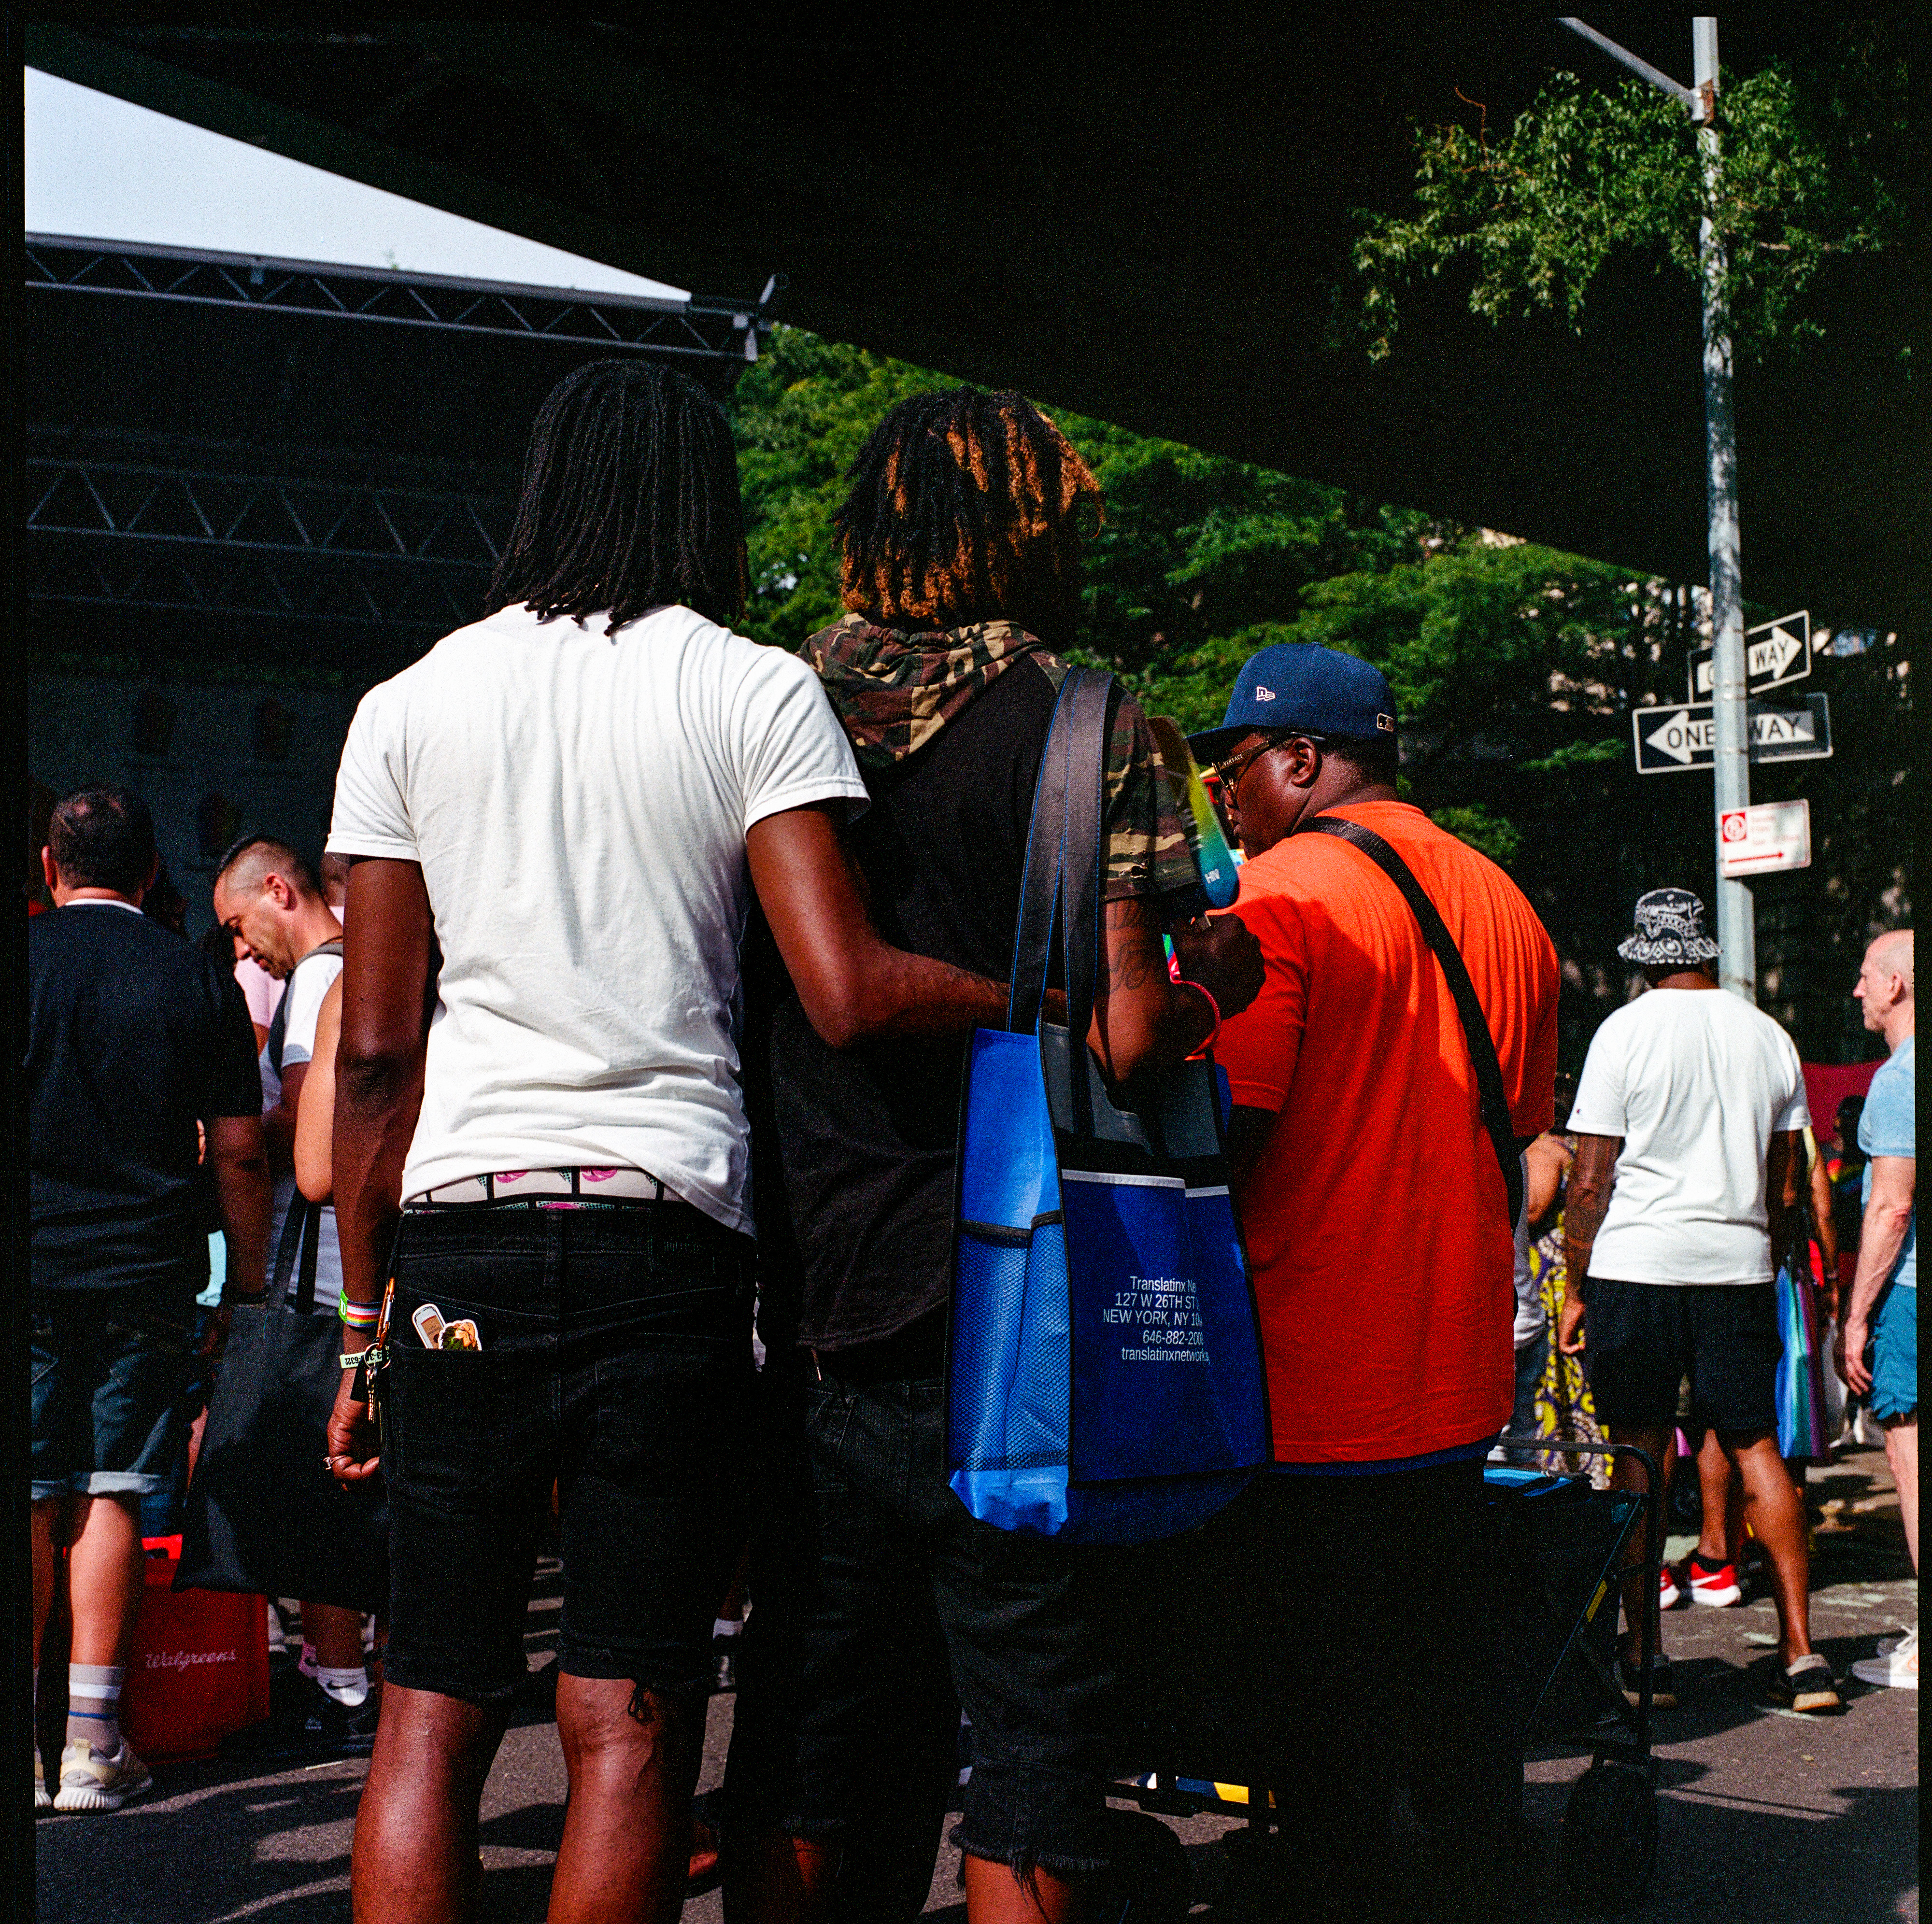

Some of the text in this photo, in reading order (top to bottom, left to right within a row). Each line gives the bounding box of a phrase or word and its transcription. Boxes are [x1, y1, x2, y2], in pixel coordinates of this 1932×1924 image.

[1755, 639, 1789, 669] WAY
[1667, 716, 1801, 749] ONE WAY
[1130, 1276, 1185, 1292] Translatinx
[1116, 1292, 1137, 1306] 127
[1141, 1293, 1152, 1307] W
[1155, 1294, 1182, 1308] 26TH
[1103, 1309, 1132, 1323] NEW
[1135, 1310, 1171, 1327] YORK,
[1174, 1312, 1189, 1326] NY
[145, 1649, 238, 1672] Walgreens
